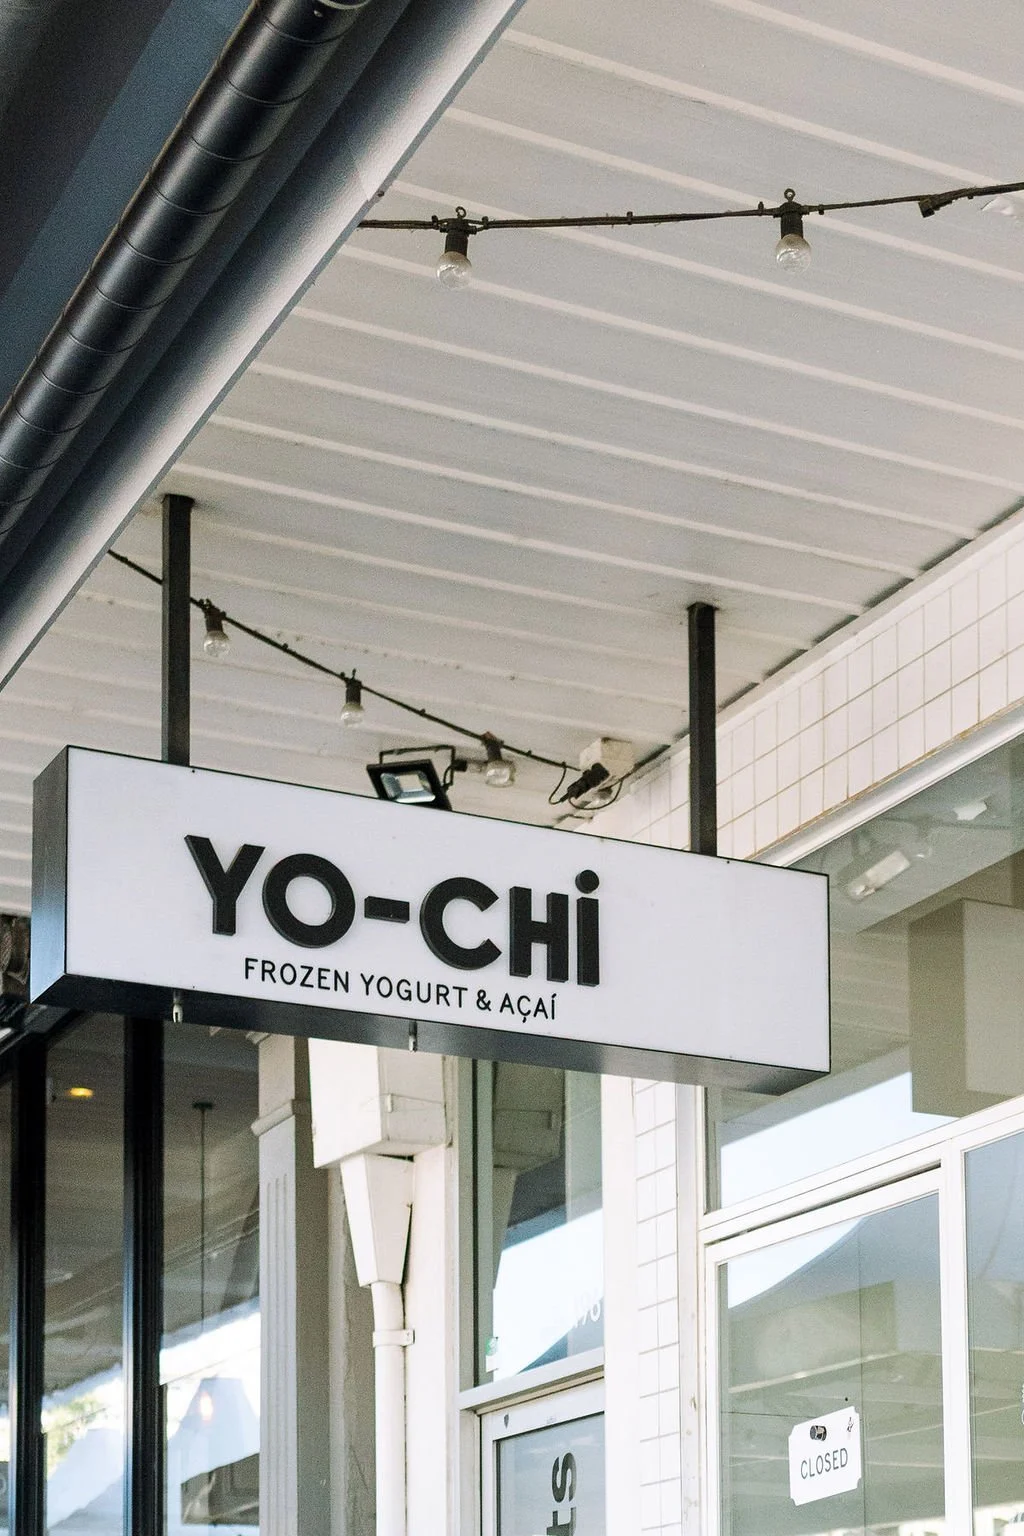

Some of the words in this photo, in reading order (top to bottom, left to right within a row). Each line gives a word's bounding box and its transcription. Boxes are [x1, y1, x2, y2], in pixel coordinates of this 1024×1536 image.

[243, 956, 351, 995] FROZEN
[360, 973, 468, 1010] YOGURT
[475, 990, 492, 1012] &
[499, 993, 557, 1023] AÇAÍ
[800, 1447, 849, 1480] CLOSED
